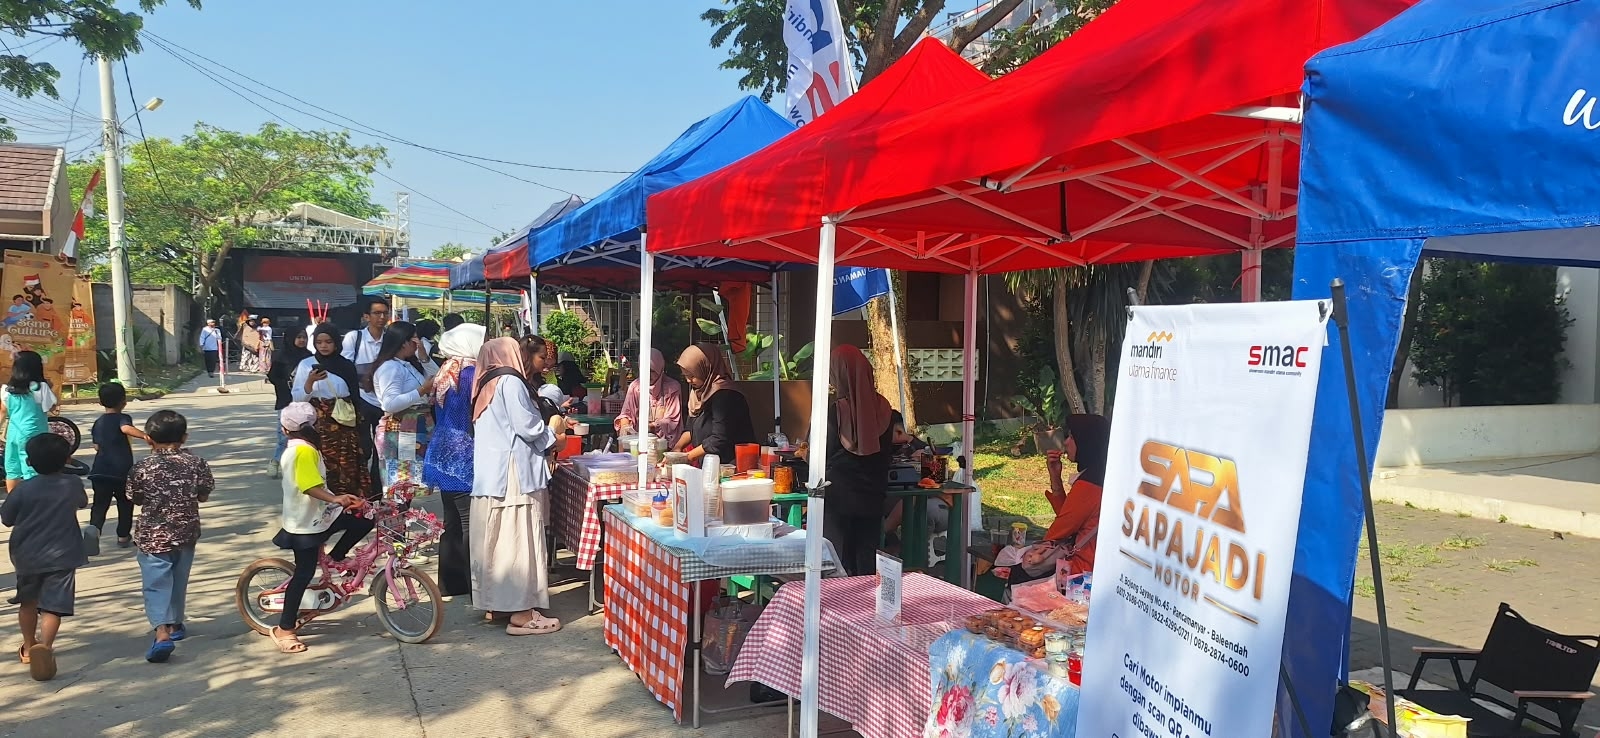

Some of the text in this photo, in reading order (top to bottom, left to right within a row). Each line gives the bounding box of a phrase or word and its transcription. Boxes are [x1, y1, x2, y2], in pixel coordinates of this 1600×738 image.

[8, 324, 59, 337] Culture
[1130, 340, 1163, 359] mandiri
[1128, 360, 1178, 381] utama finance
[1248, 344, 1309, 368] smac
[1137, 439, 1246, 534] SAPA
[1121, 499, 1266, 601] SAPAJADI
[1154, 561, 1199, 602] MOTOR
[1139, 585, 1155, 604] Sayang
[1211, 629, 1248, 658] Baleendah
[1193, 636, 1250, 677] 0878-2874-0600
[1120, 674, 1183, 738] dengan scan QR
[1123, 652, 1213, 737] Cari Motor impianmu
